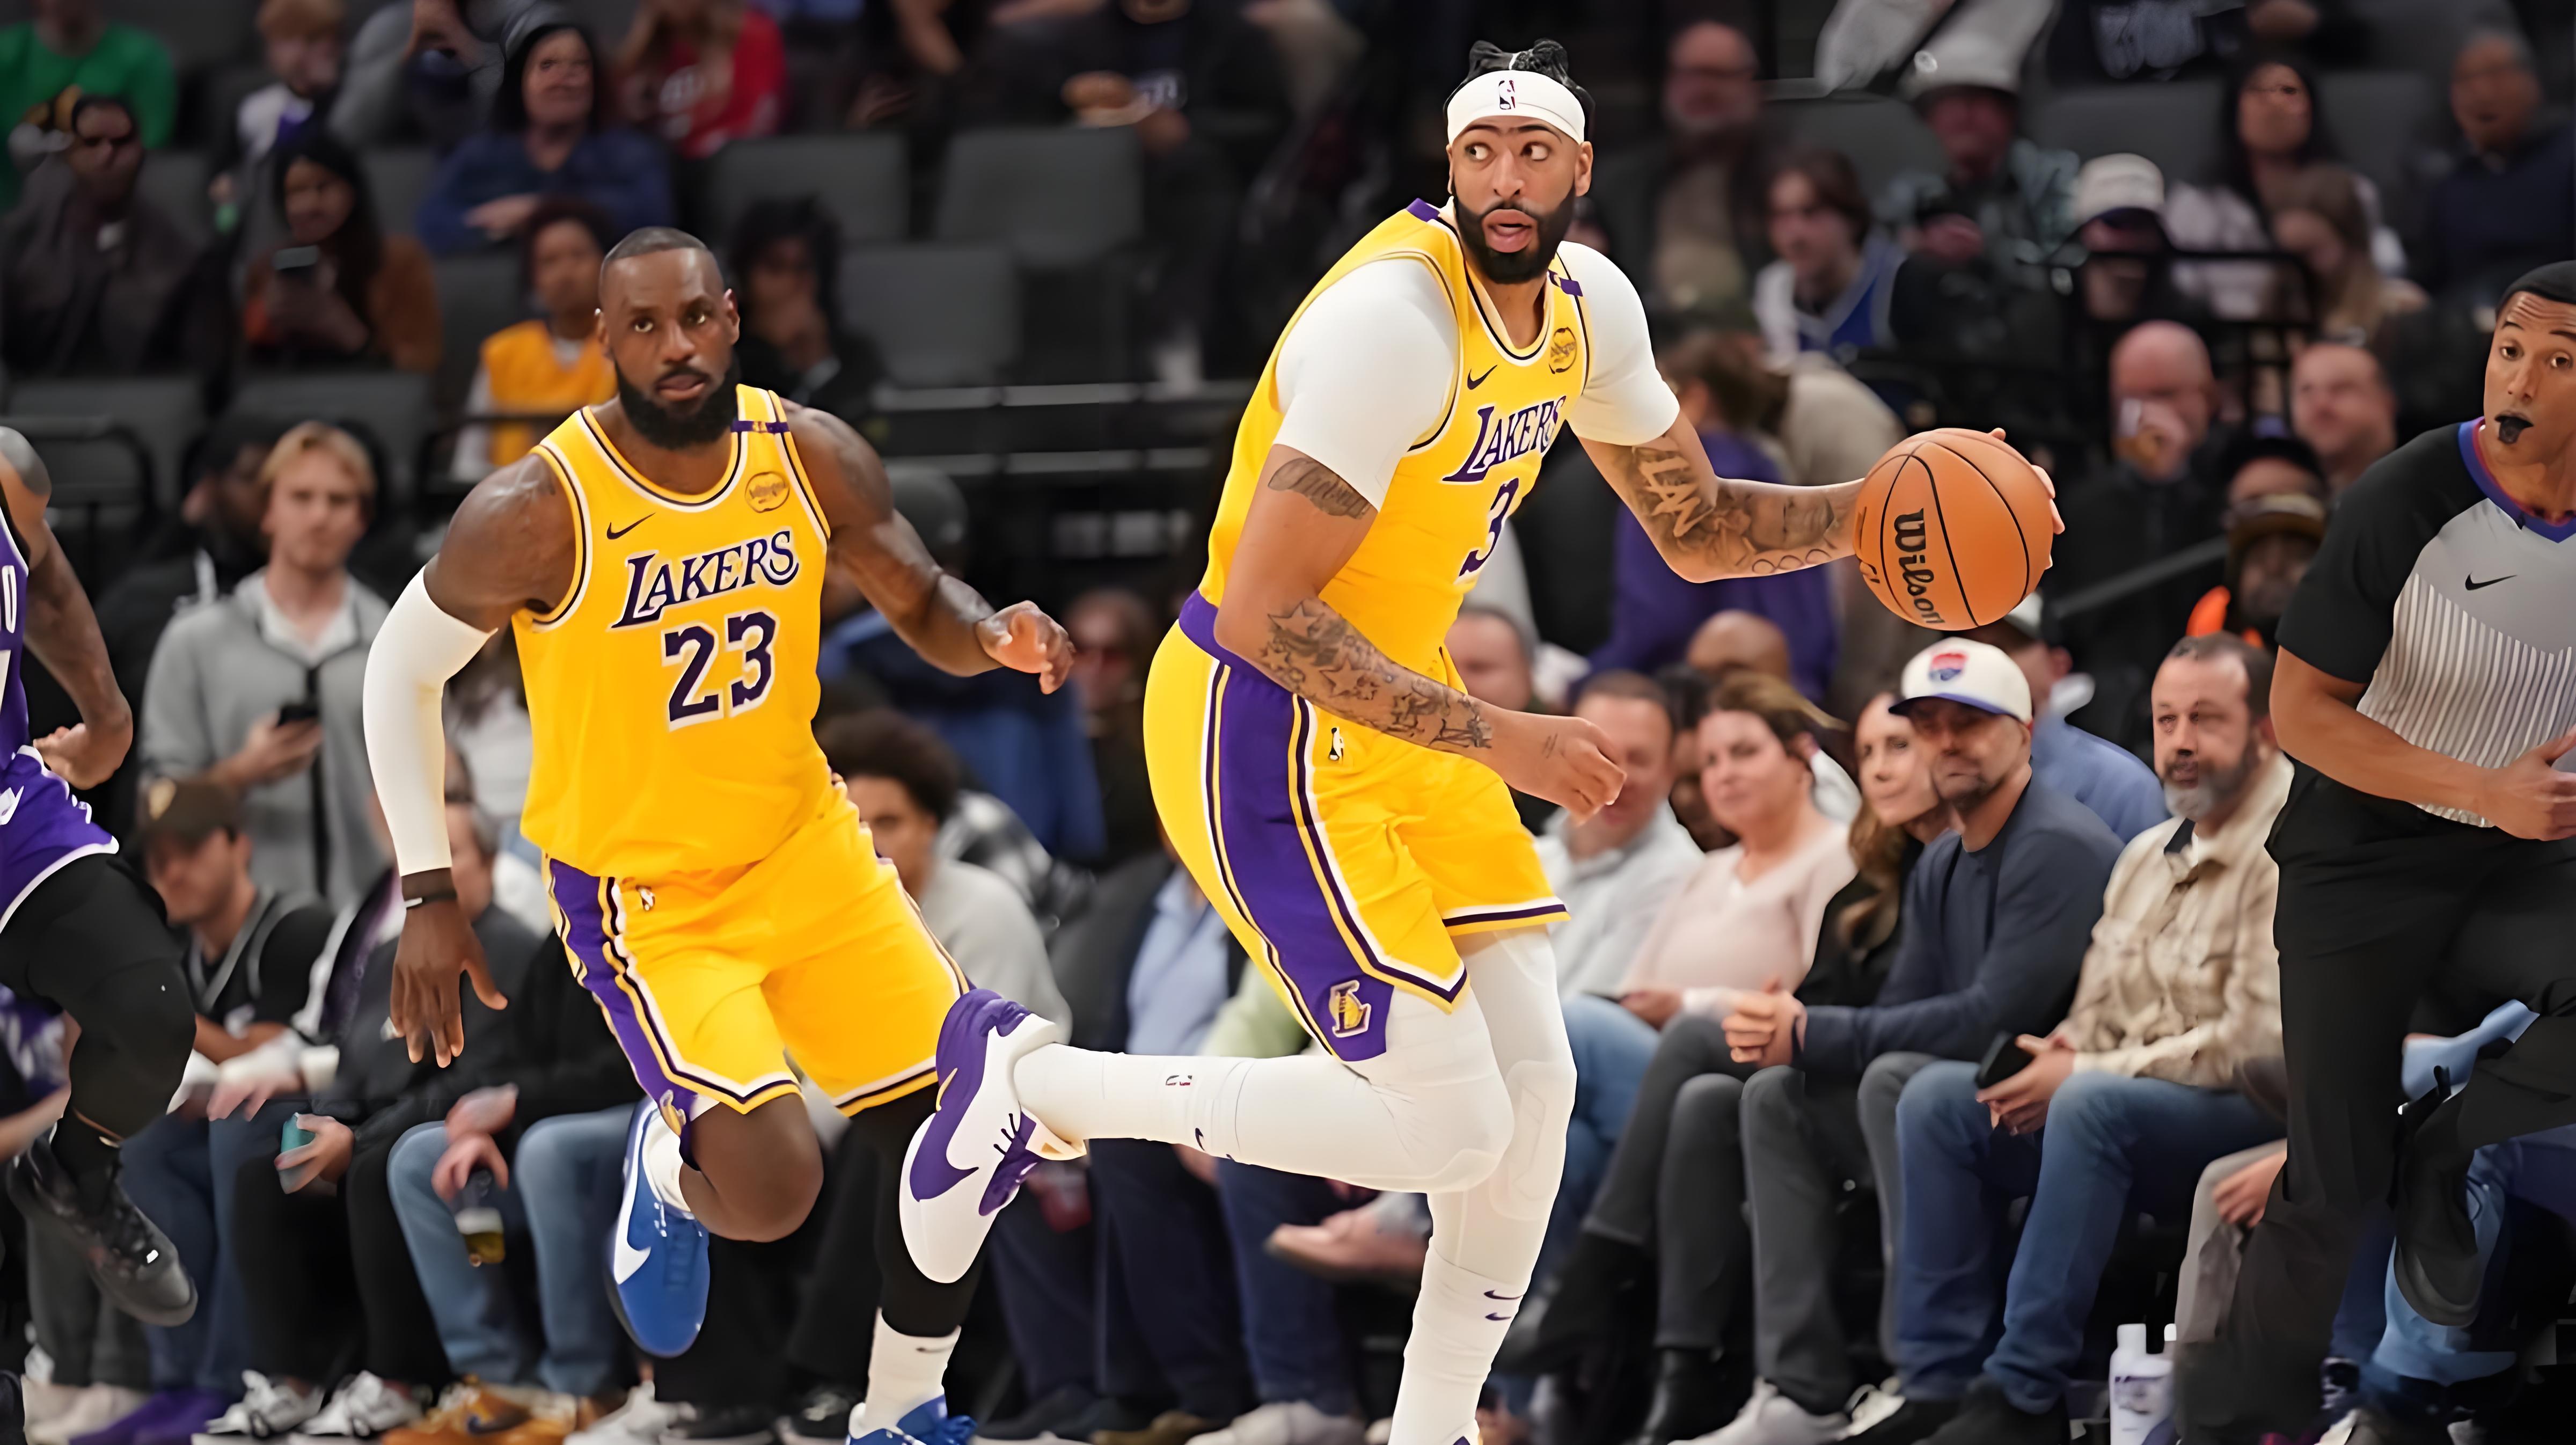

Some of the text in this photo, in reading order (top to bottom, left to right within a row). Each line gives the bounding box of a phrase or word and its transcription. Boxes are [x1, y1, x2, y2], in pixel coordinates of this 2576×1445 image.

[1441, 395, 1566, 482] LAKERS
[610, 529, 800, 630] LAKERS
[1457, 477, 1520, 580] 3
[1893, 507, 1946, 624] Wilson
[662, 609, 778, 726] 23
